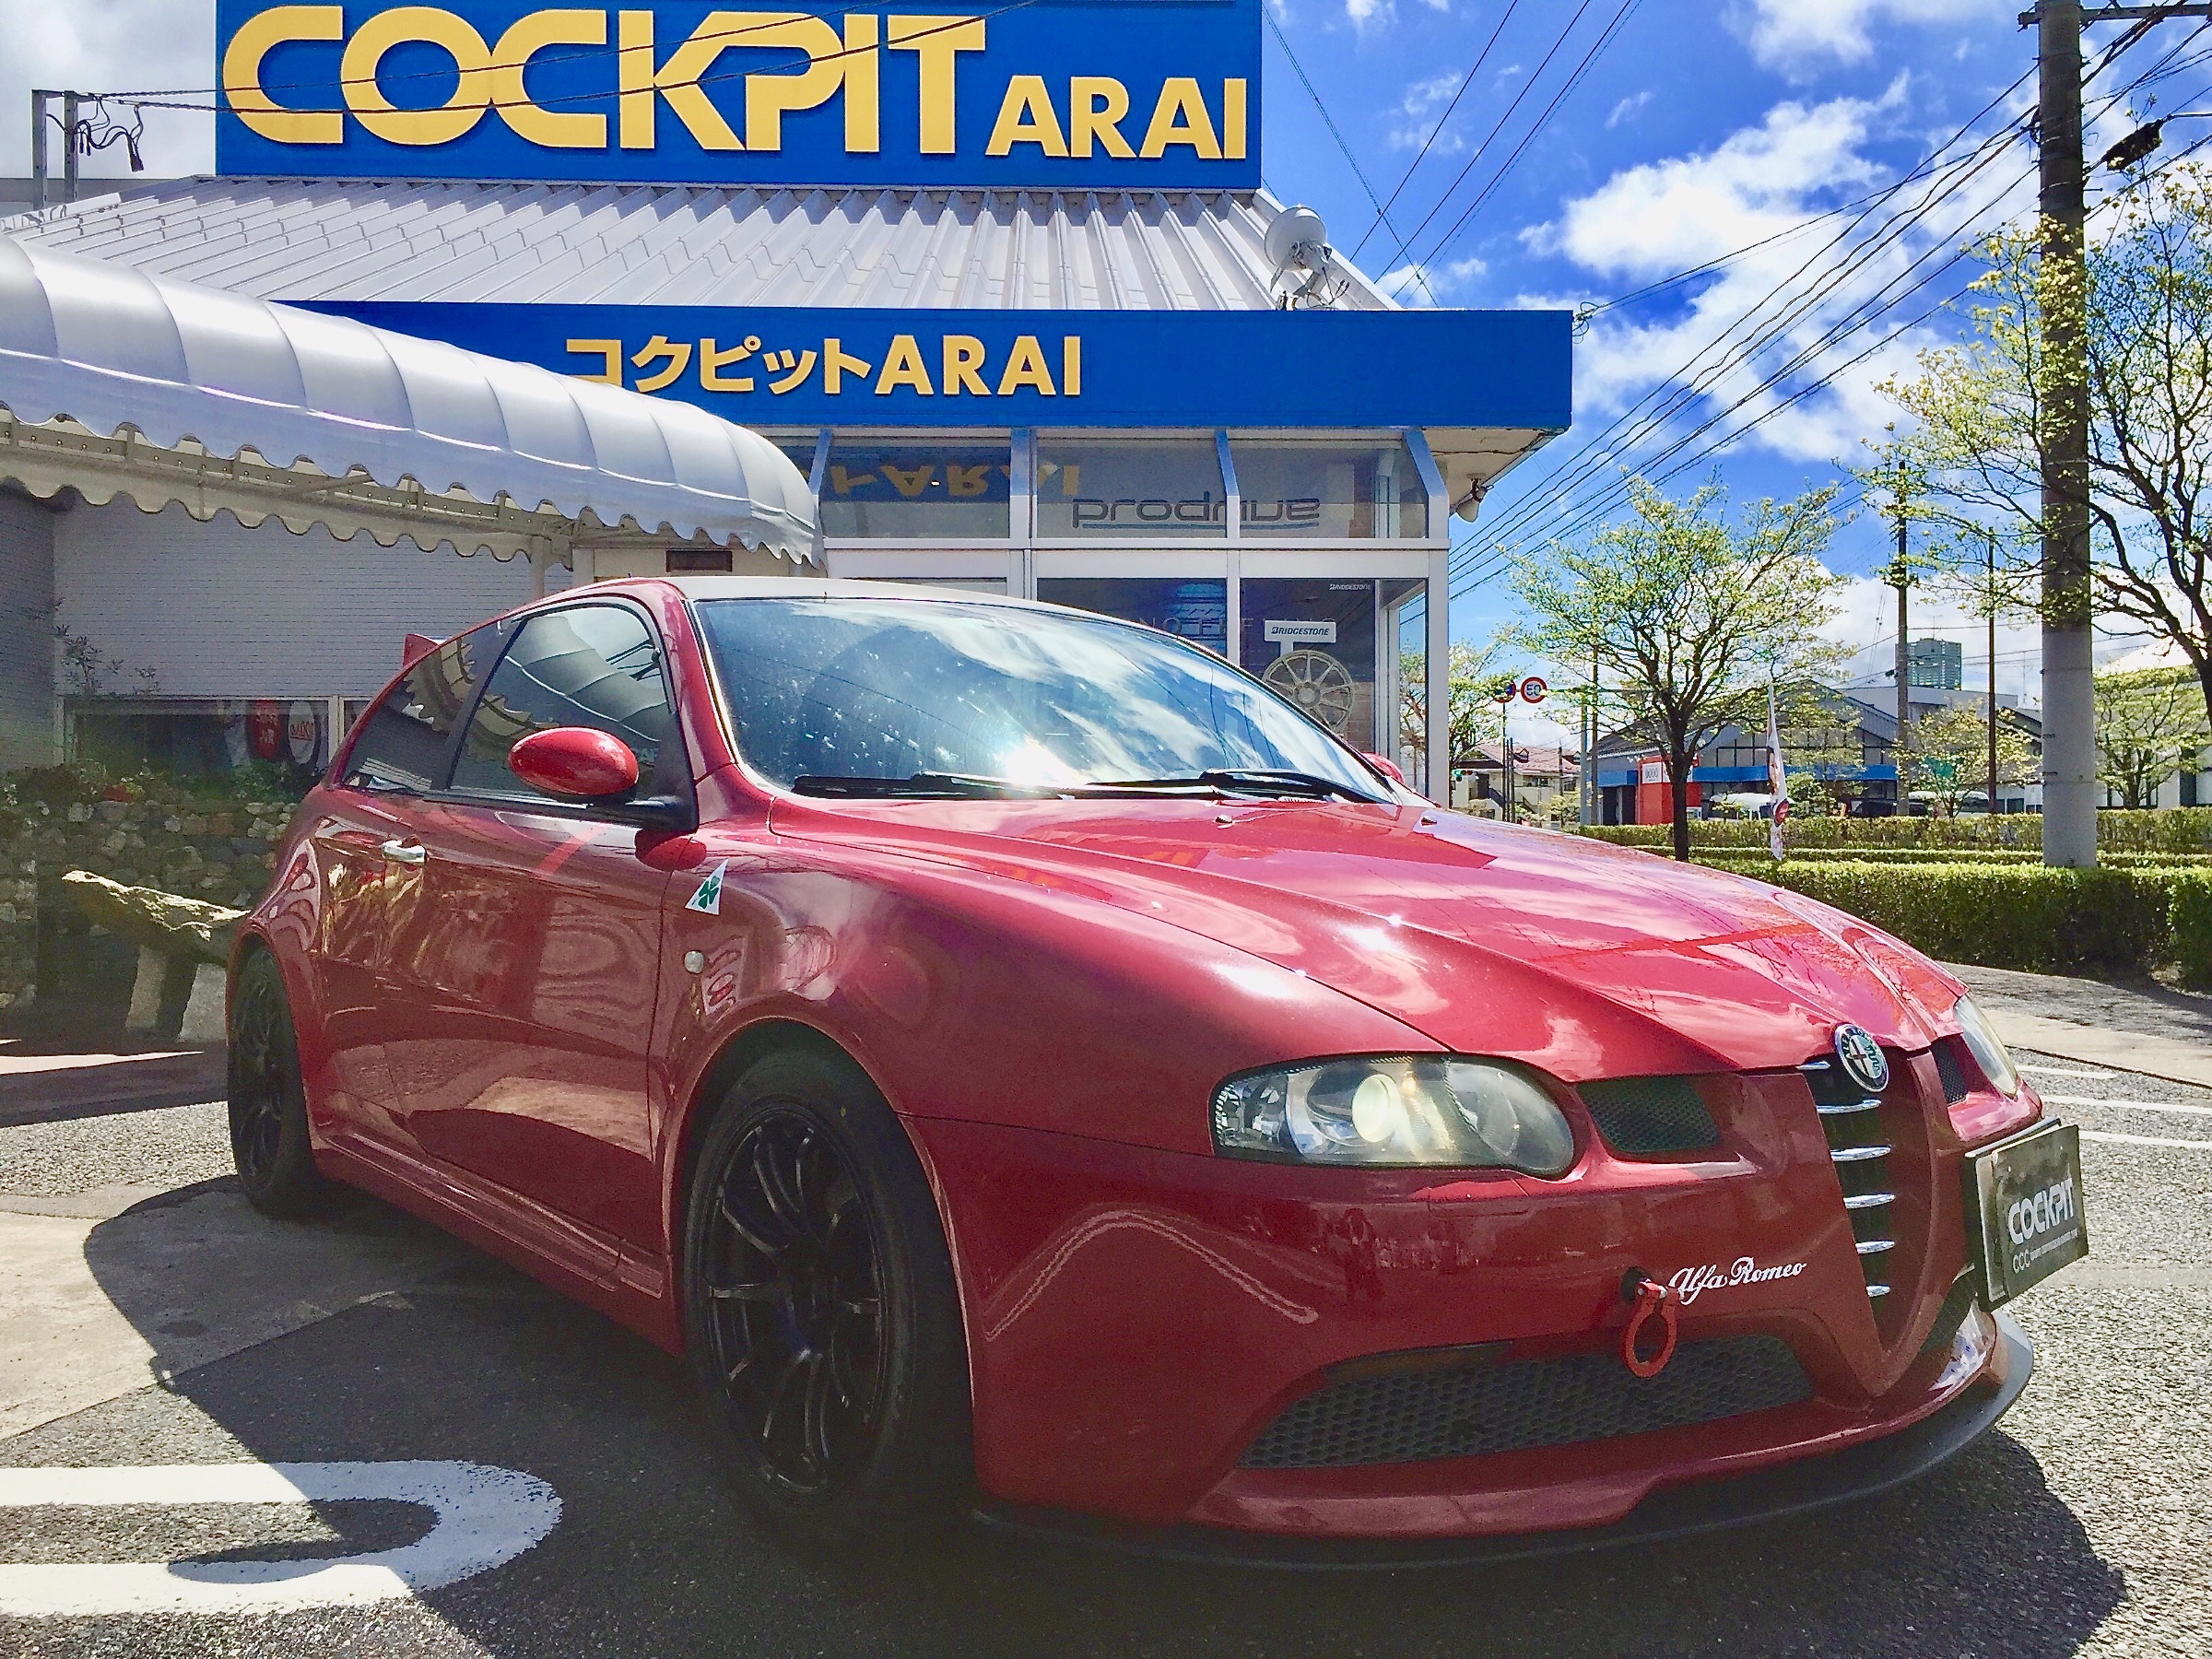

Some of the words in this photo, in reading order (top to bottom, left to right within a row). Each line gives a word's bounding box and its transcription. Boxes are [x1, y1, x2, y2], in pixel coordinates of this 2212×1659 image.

[223, 5, 986, 154] COCKPIT
[986, 75, 1247, 159] ARAI
[1271, 627, 1330, 636] BRIDGESTONE
[1526, 684, 1542, 696] 50
[2008, 1178, 2074, 1245] COCKPIT
[1668, 1265, 1728, 1305] Alfa
[1729, 1257, 1807, 1286] Romeo
